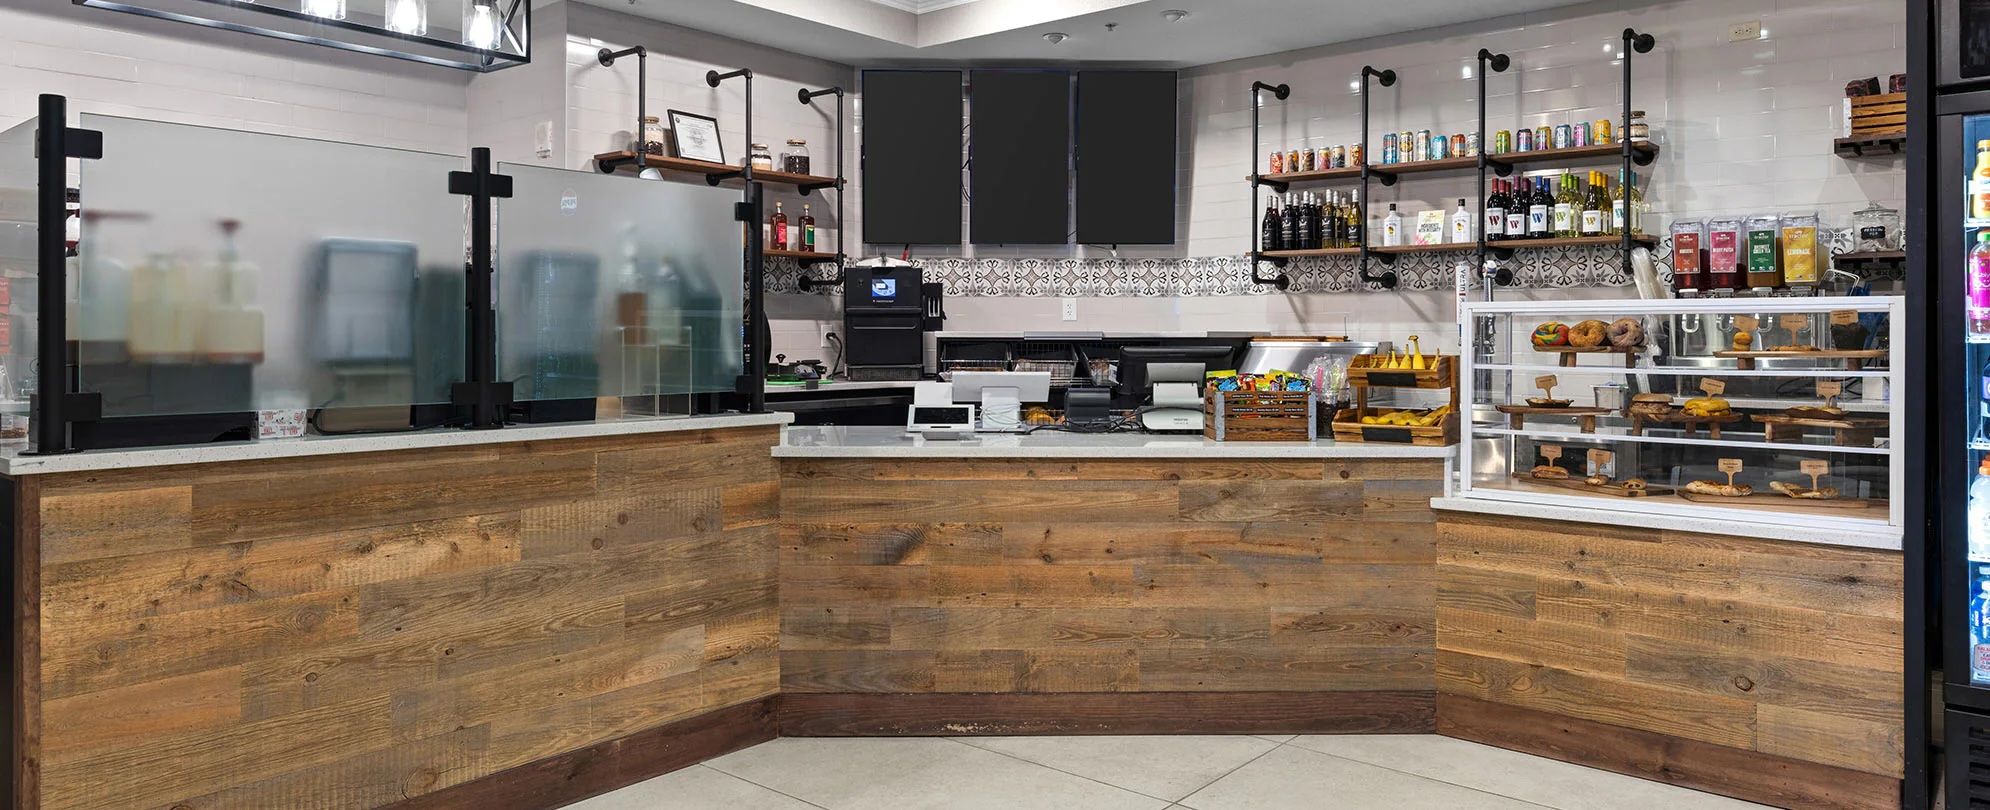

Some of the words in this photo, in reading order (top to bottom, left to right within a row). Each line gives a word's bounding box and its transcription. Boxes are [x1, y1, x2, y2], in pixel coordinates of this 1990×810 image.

[1488, 215, 1500, 226] W
[1532, 212, 1543, 224] W
[1509, 220, 1520, 229] W
[1787, 248, 1811, 256] LEMONADE
[1459, 268, 1467, 292] ULTRA
